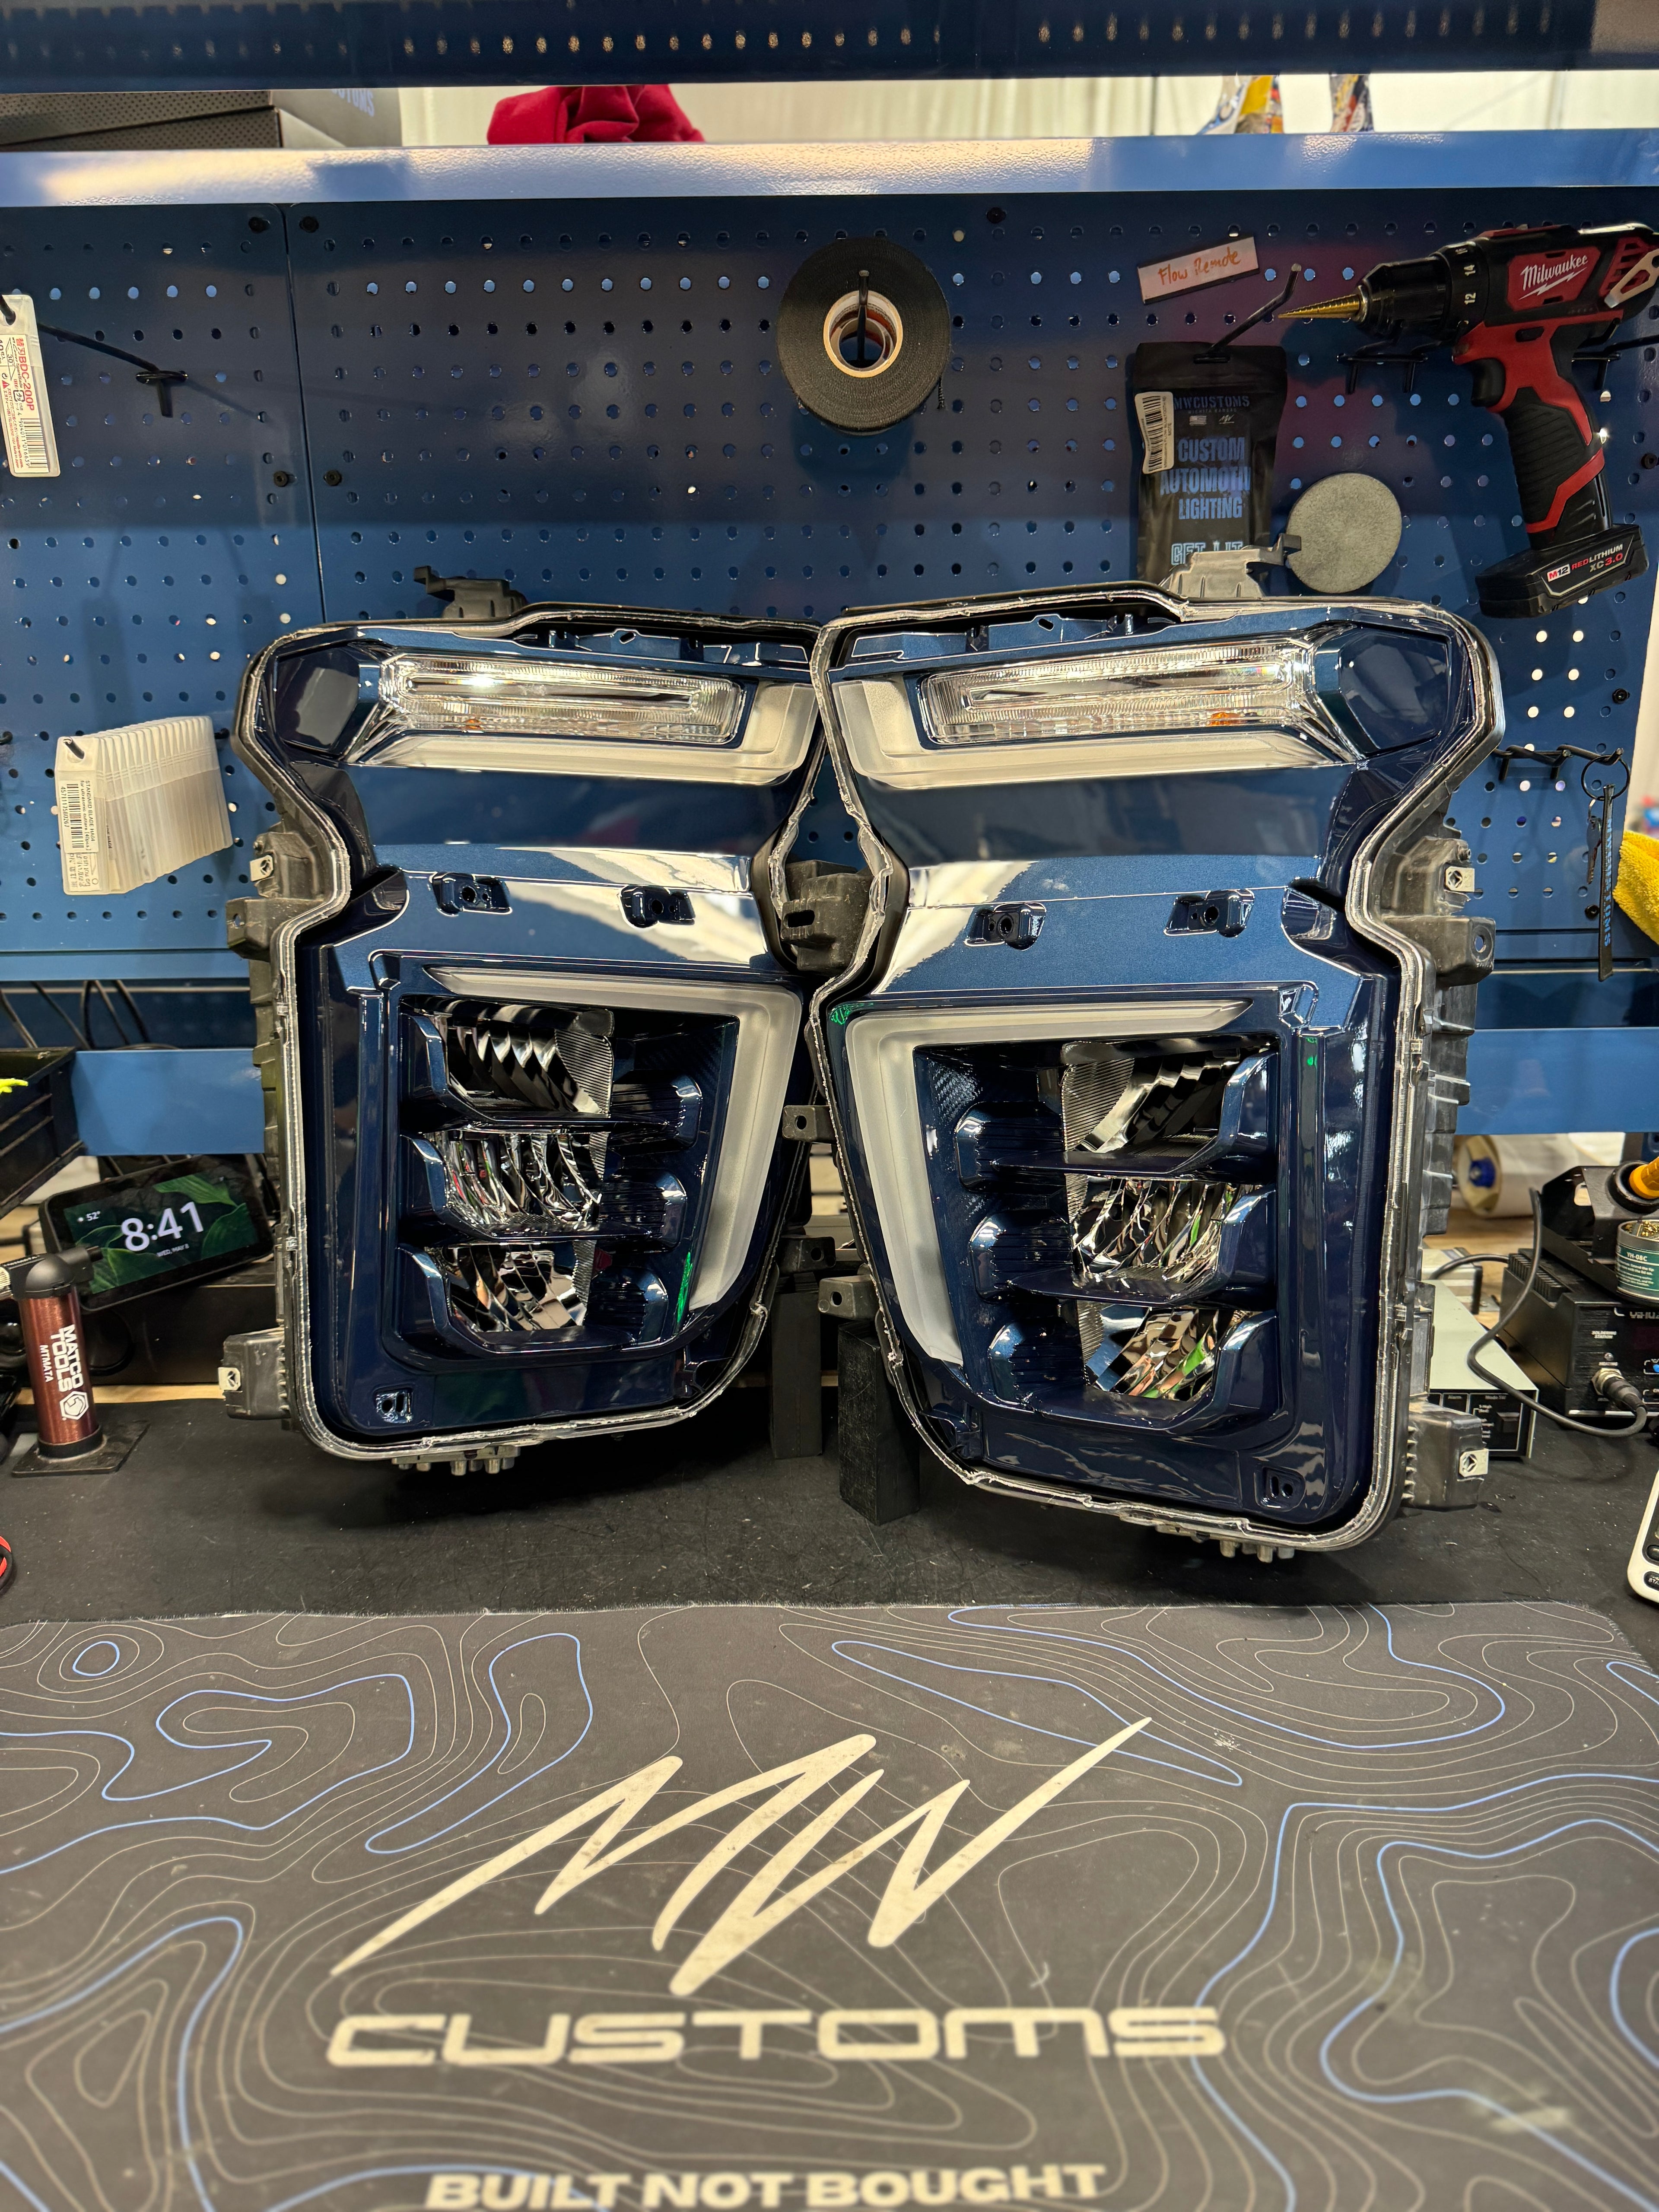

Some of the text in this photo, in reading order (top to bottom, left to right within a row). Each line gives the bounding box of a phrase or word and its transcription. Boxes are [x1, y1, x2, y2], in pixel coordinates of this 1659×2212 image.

[1157, 246, 1241, 285] Flow Remote
[1464, 264, 1476, 276] 14
[1520, 254, 1589, 291] Milwaukee
[1464, 292, 1477, 305] 12
[1173, 395, 1250, 410] MWCUSTOMS
[1178, 436, 1245, 463] CUSTOM
[1178, 497, 1243, 520] LIGHTING
[1548, 566, 1569, 580] M12
[1571, 543, 1623, 570] REDLITHIUM
[121, 1201, 204, 1252] 8:41
[39, 1344, 54, 1382] MTMATA
[50, 1328, 73, 1392] TOOLS
[63, 1324, 84, 1389] MATCO
[327, 2006, 1227, 2069] CUSTOMS
[425, 2164, 1108, 2211] BUILT NOT BOUGHT
